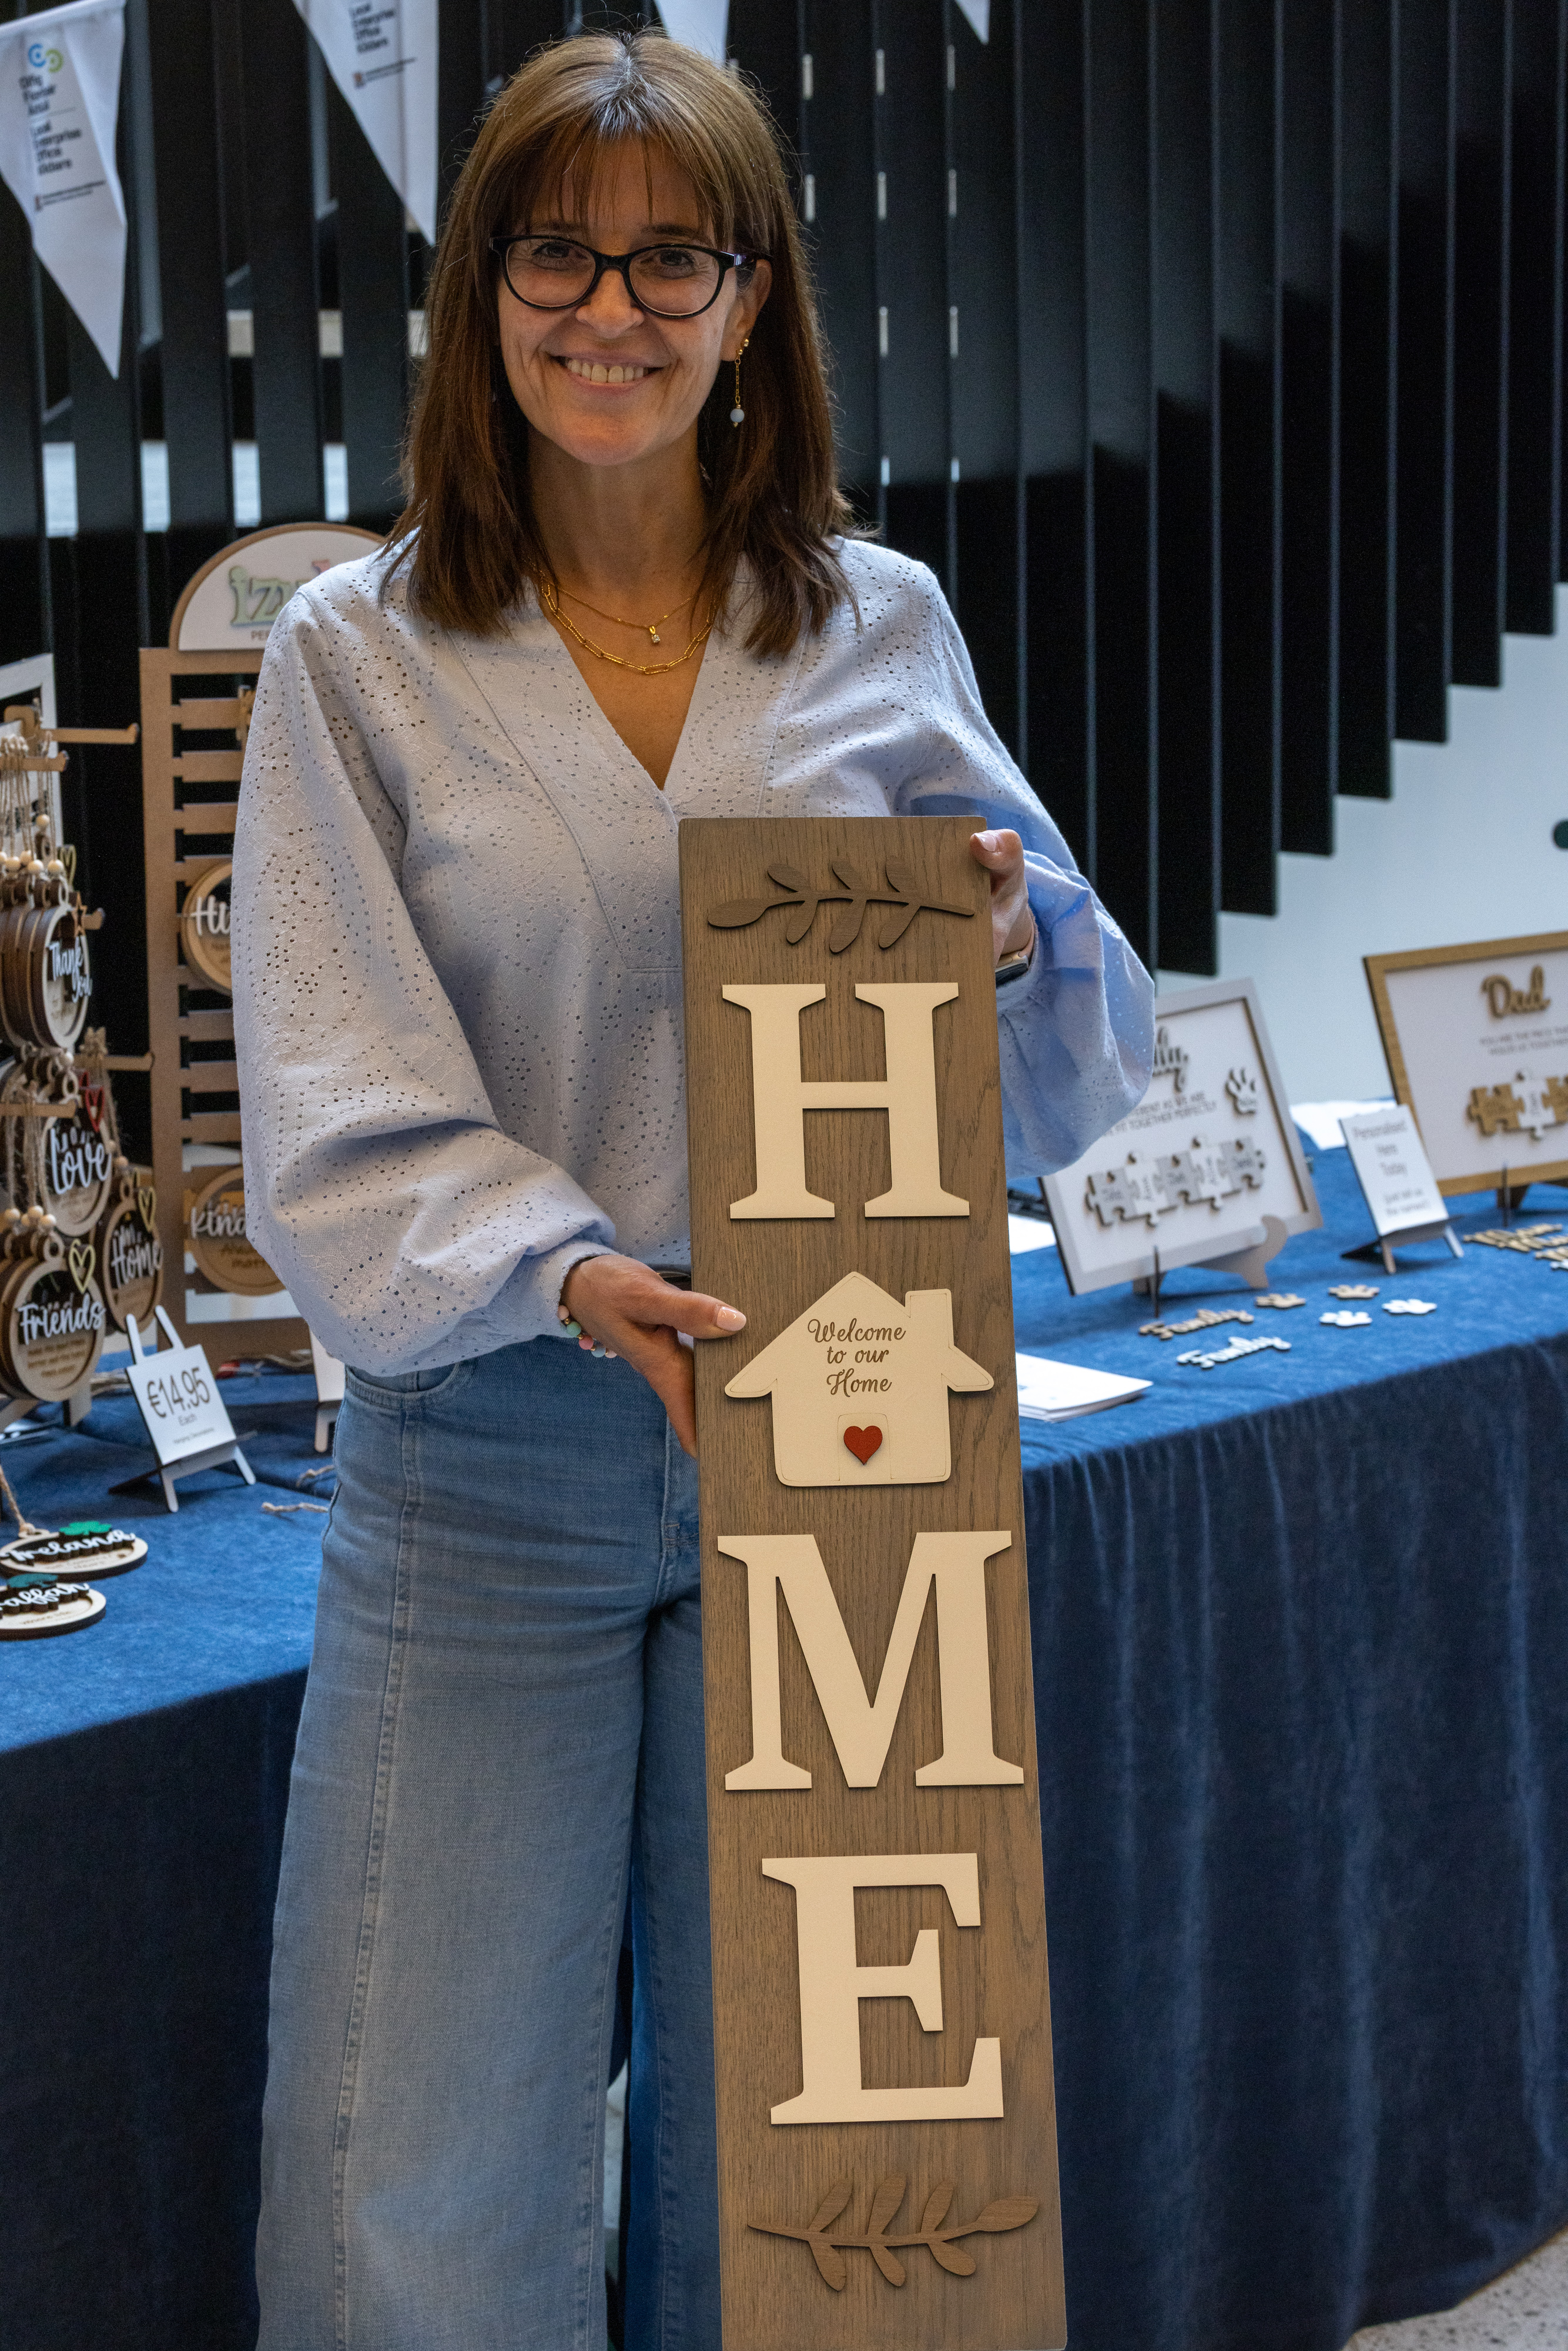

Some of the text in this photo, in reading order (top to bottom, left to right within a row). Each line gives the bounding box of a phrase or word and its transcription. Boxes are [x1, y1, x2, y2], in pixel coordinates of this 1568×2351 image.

[18, 1293, 106, 1345] Friends
[808, 1318, 906, 1343] Welcome
[827, 1346, 889, 1364] to our
[148, 1367, 210, 1419] €14.95
[826, 1368, 892, 1398] Home
